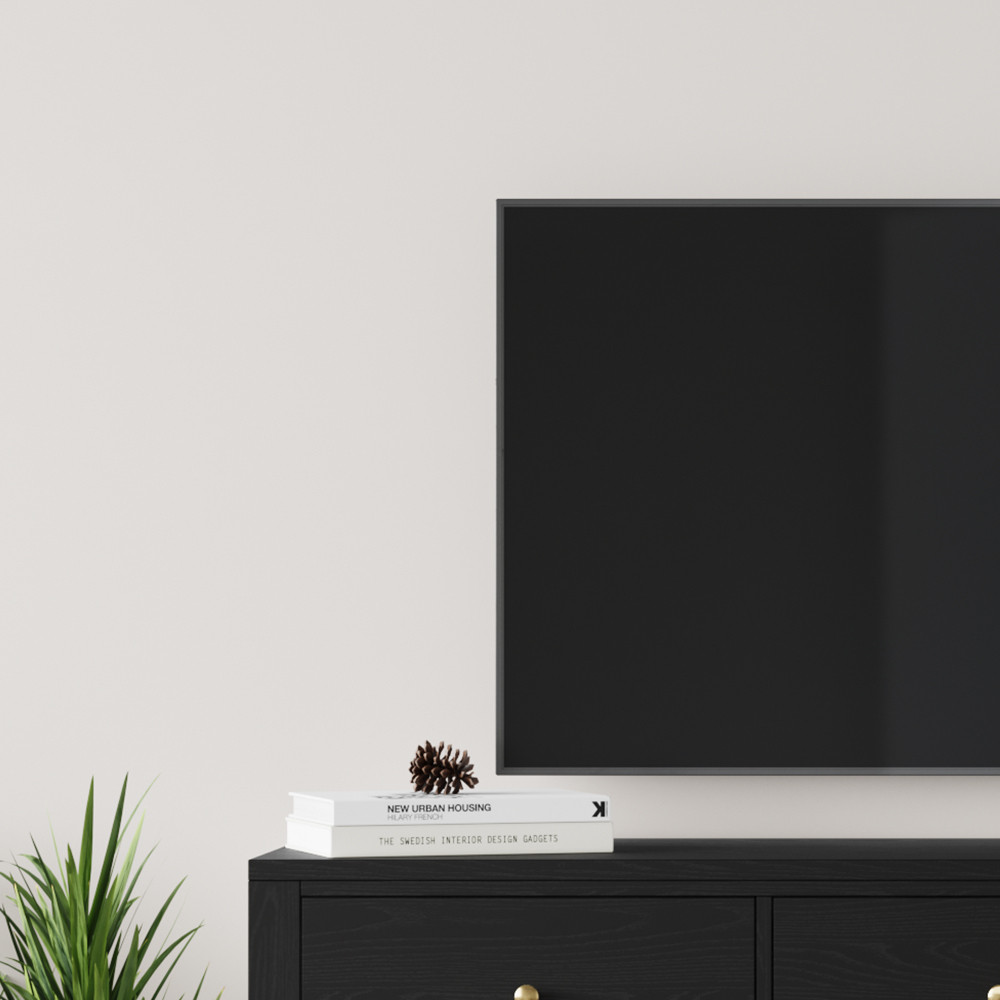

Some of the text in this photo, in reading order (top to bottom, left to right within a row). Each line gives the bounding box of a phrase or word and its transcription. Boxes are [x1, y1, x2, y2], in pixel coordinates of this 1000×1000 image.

[387, 803, 491, 813] NEW URBAN HOUSING
[387, 813, 443, 821] HILARY FRENCH
[379, 835, 559, 846] THE SWEDISH INTERIOR DESIGN GADGETS
